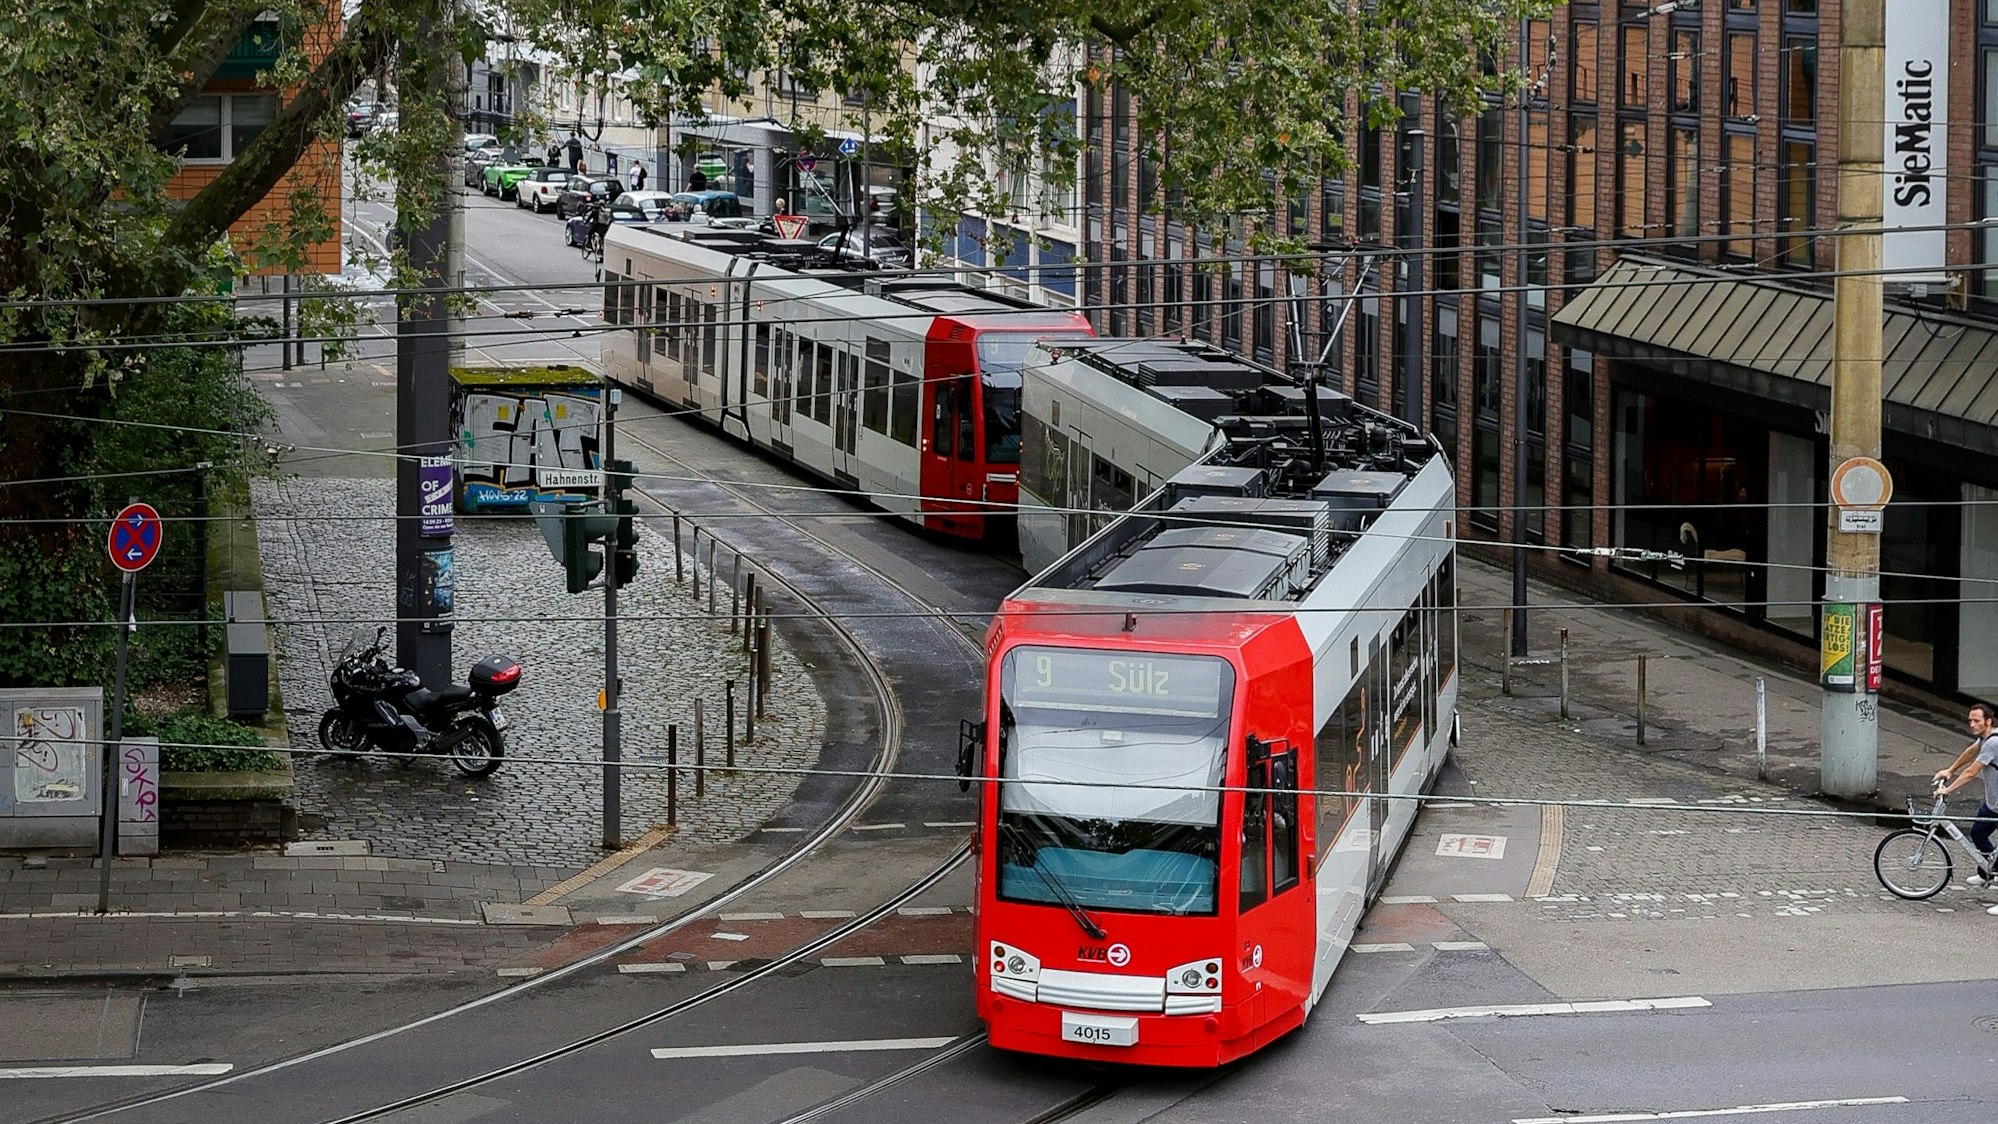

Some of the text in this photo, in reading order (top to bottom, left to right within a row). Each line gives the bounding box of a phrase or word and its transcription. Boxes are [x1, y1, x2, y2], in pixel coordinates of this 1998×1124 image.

[1893, 59, 1932, 207] SieMatic
[545, 473, 600, 485] Hahnenstr.
[421, 480, 439, 492] OF
[421, 502, 453, 515] CRIME
[1828, 642, 1849, 653] LOS!
[1035, 655, 1169, 695] 9 Sülz
[1078, 946, 1107, 960] KVB
[1074, 1026, 1111, 1041] 4015
